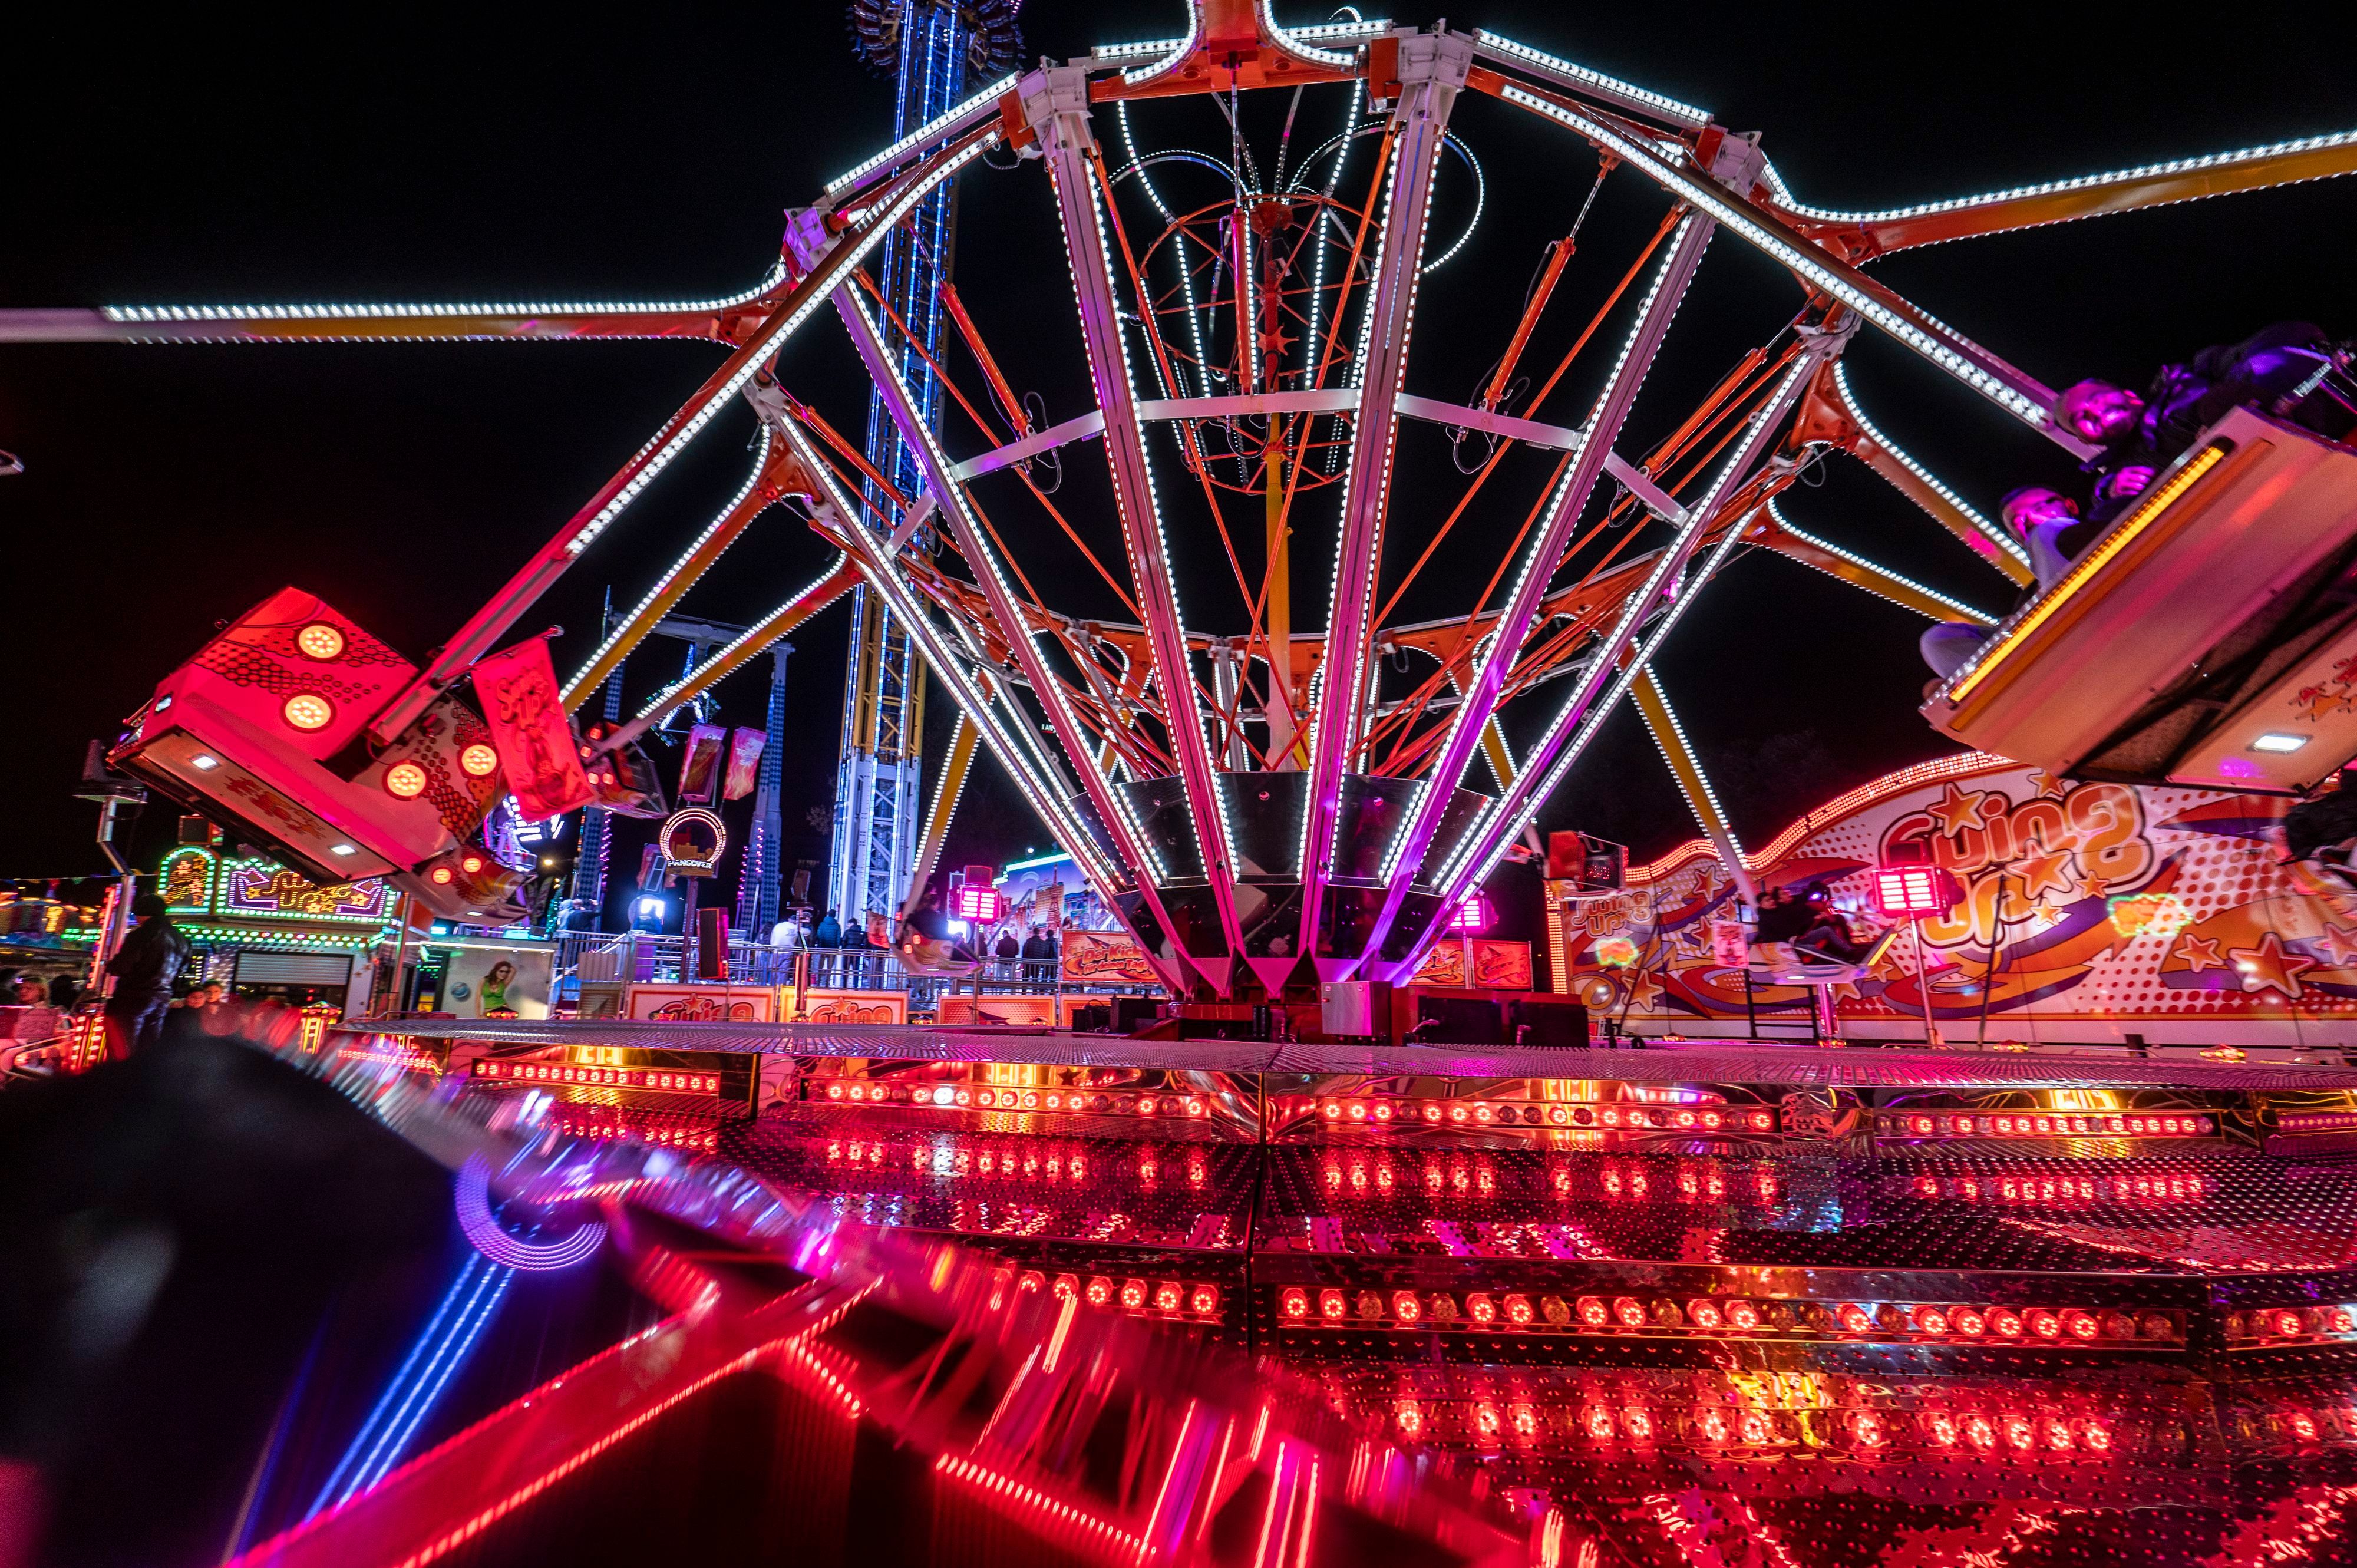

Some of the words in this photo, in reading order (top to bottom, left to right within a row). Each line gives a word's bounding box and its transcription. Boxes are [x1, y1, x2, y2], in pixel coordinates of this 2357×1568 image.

[667, 860, 712, 869] HANGOVER
[1082, 948, 1108, 965] Der
[1098, 960, 1125, 972] deinen
